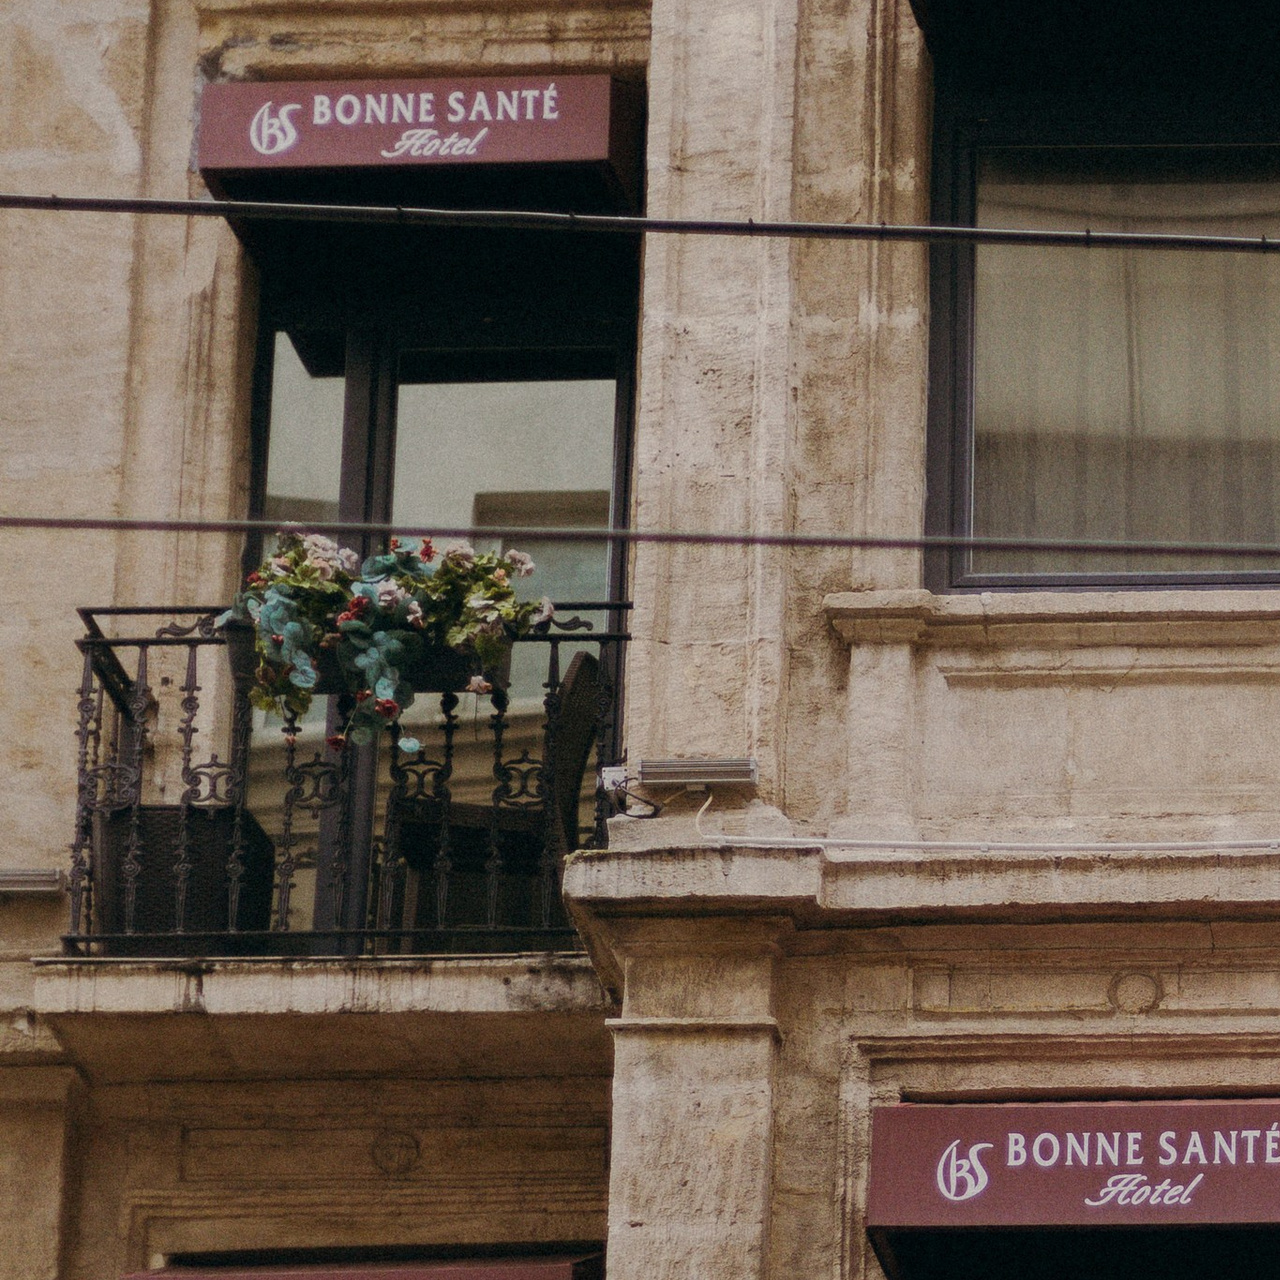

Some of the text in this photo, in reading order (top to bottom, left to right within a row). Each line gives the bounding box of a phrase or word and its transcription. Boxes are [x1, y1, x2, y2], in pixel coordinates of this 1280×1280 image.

[312, 82, 559, 126] BONNE SANTÉ
[380, 126, 489, 159] Hotel
[1006, 1131, 1145, 1167] BONNE
[1084, 1172, 1205, 1207] Hotel
